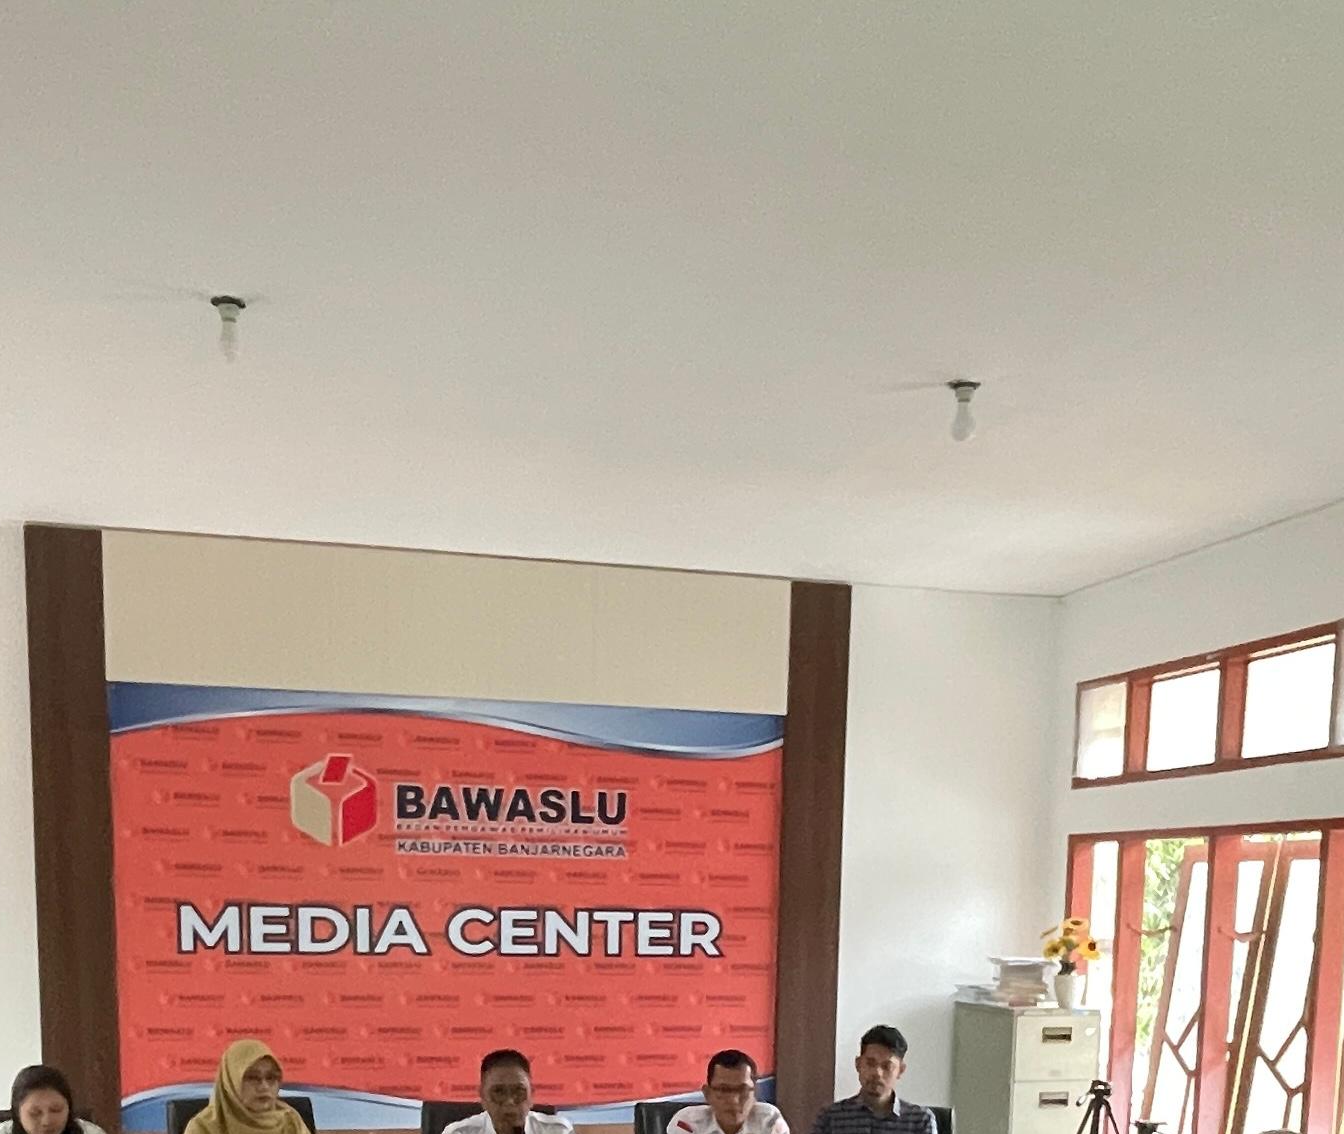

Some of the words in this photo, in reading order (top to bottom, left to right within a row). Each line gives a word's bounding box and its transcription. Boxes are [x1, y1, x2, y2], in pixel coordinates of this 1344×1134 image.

[396, 784, 627, 825] BAWASLU
[397, 841, 493, 855] KABUPATEN
[498, 843, 626, 858] BANJARNEGARA
[176, 903, 431, 955] MEDIA
[445, 906, 724, 957] CENTER
